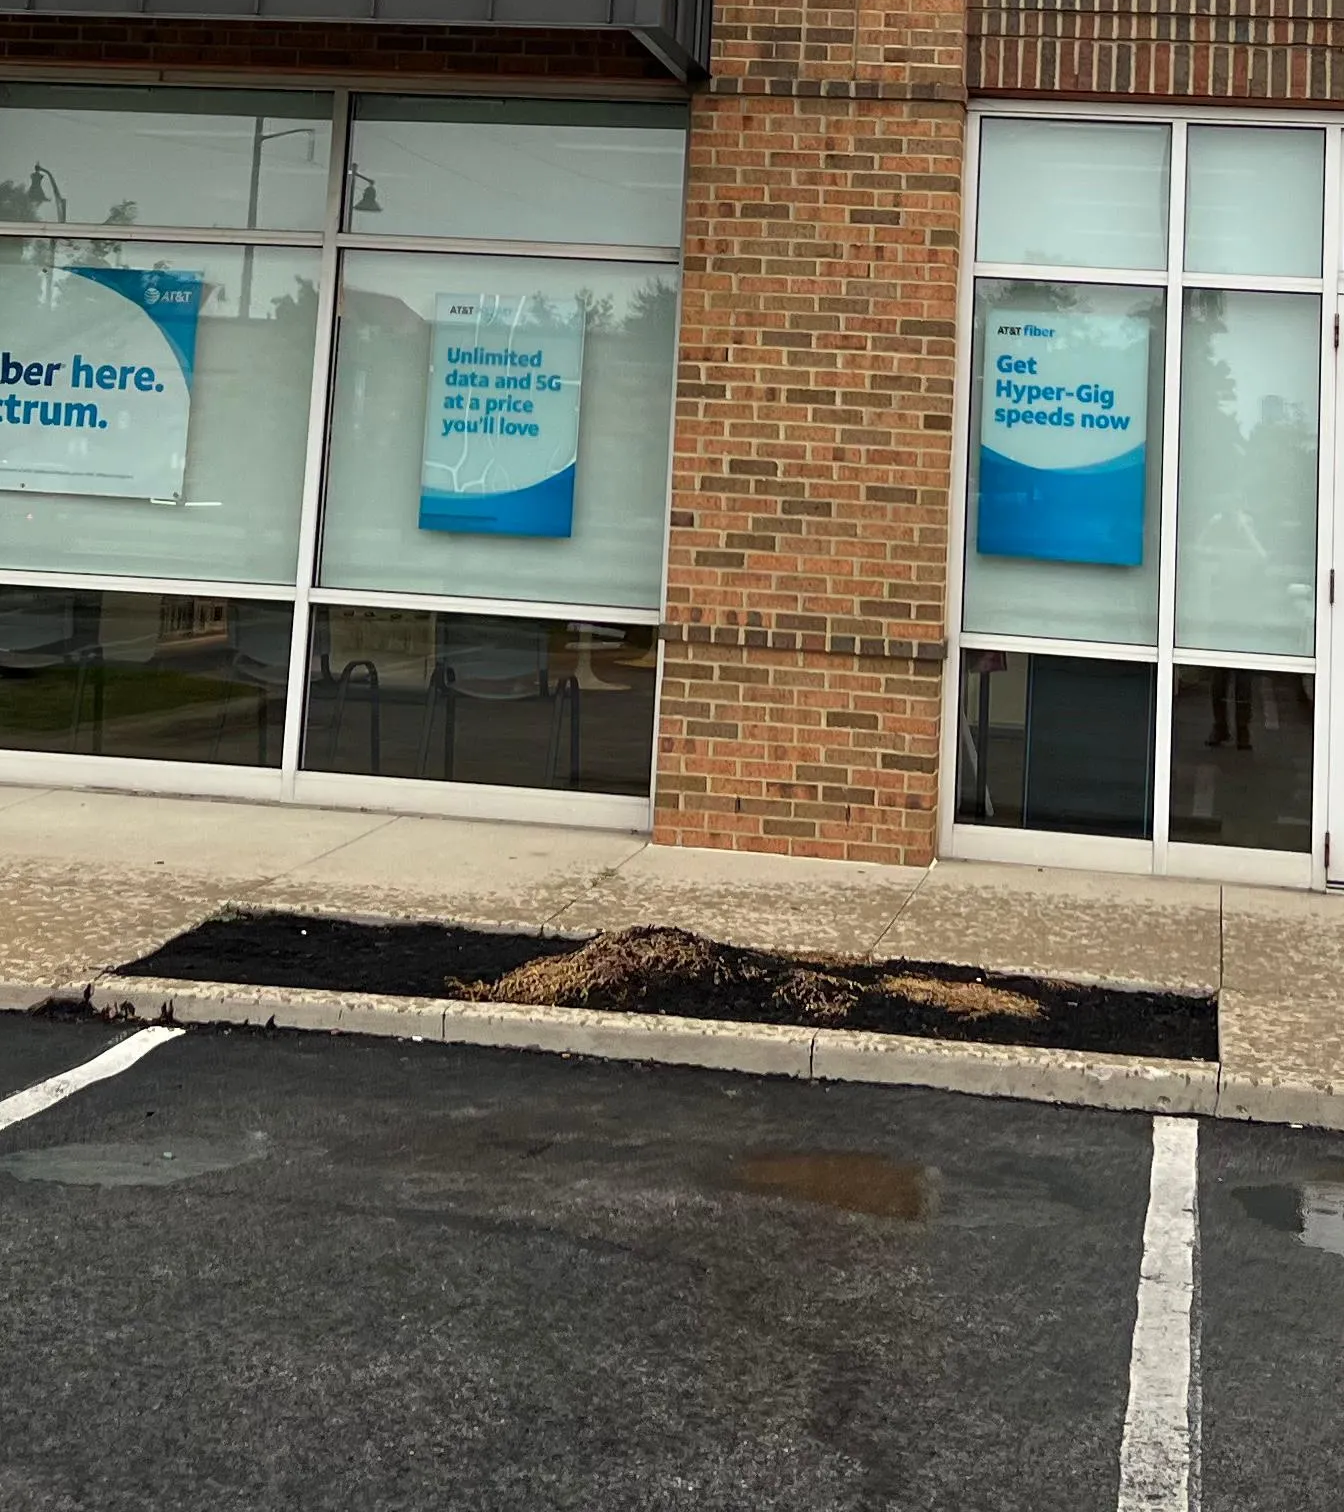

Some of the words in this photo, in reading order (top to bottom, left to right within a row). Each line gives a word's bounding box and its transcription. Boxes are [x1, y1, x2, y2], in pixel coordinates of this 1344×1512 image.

[160, 291, 192, 303] AT&T
[450, 306, 474, 315] AT&T
[997, 326, 1022, 336] AT&T
[1023, 324, 1056, 338] fiber
[447, 347, 543, 368] Unlimited
[996, 354, 1038, 375] Get
[71, 354, 164, 392] here.
[445, 369, 490, 388] data
[495, 372, 532, 390] and
[536, 374, 561, 391] 5G
[444, 394, 464, 409] at
[469, 397, 480, 410] a
[485, 394, 534, 415] price
[995, 379, 1115, 410] Hyper-Gig
[441, 416, 494, 437] you'll
[500, 417, 539, 437] love
[994, 407, 1075, 428] speeds
[1081, 413, 1131, 430] now
